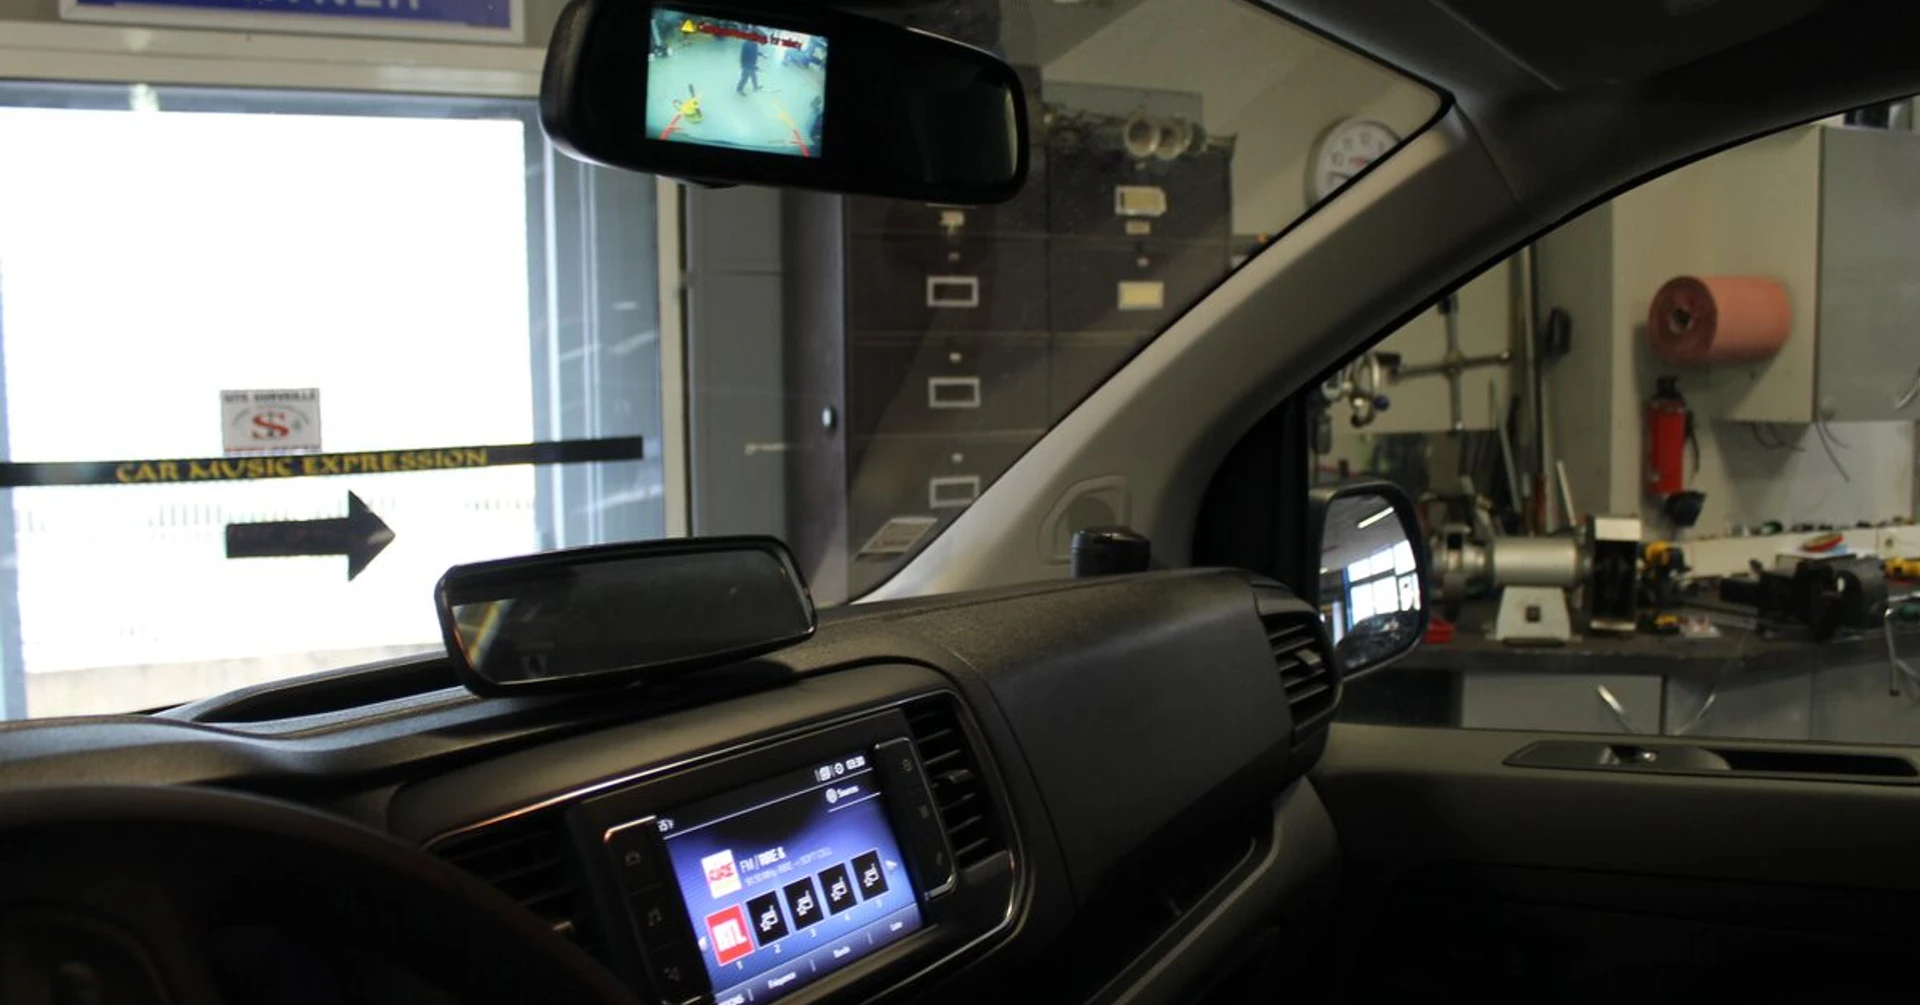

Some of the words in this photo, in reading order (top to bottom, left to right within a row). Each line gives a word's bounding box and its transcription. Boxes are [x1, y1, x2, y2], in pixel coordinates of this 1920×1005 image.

[115, 459, 180, 484] CAR
[188, 455, 295, 480] MUSIC
[302, 448, 489, 475] EXPRESSION
